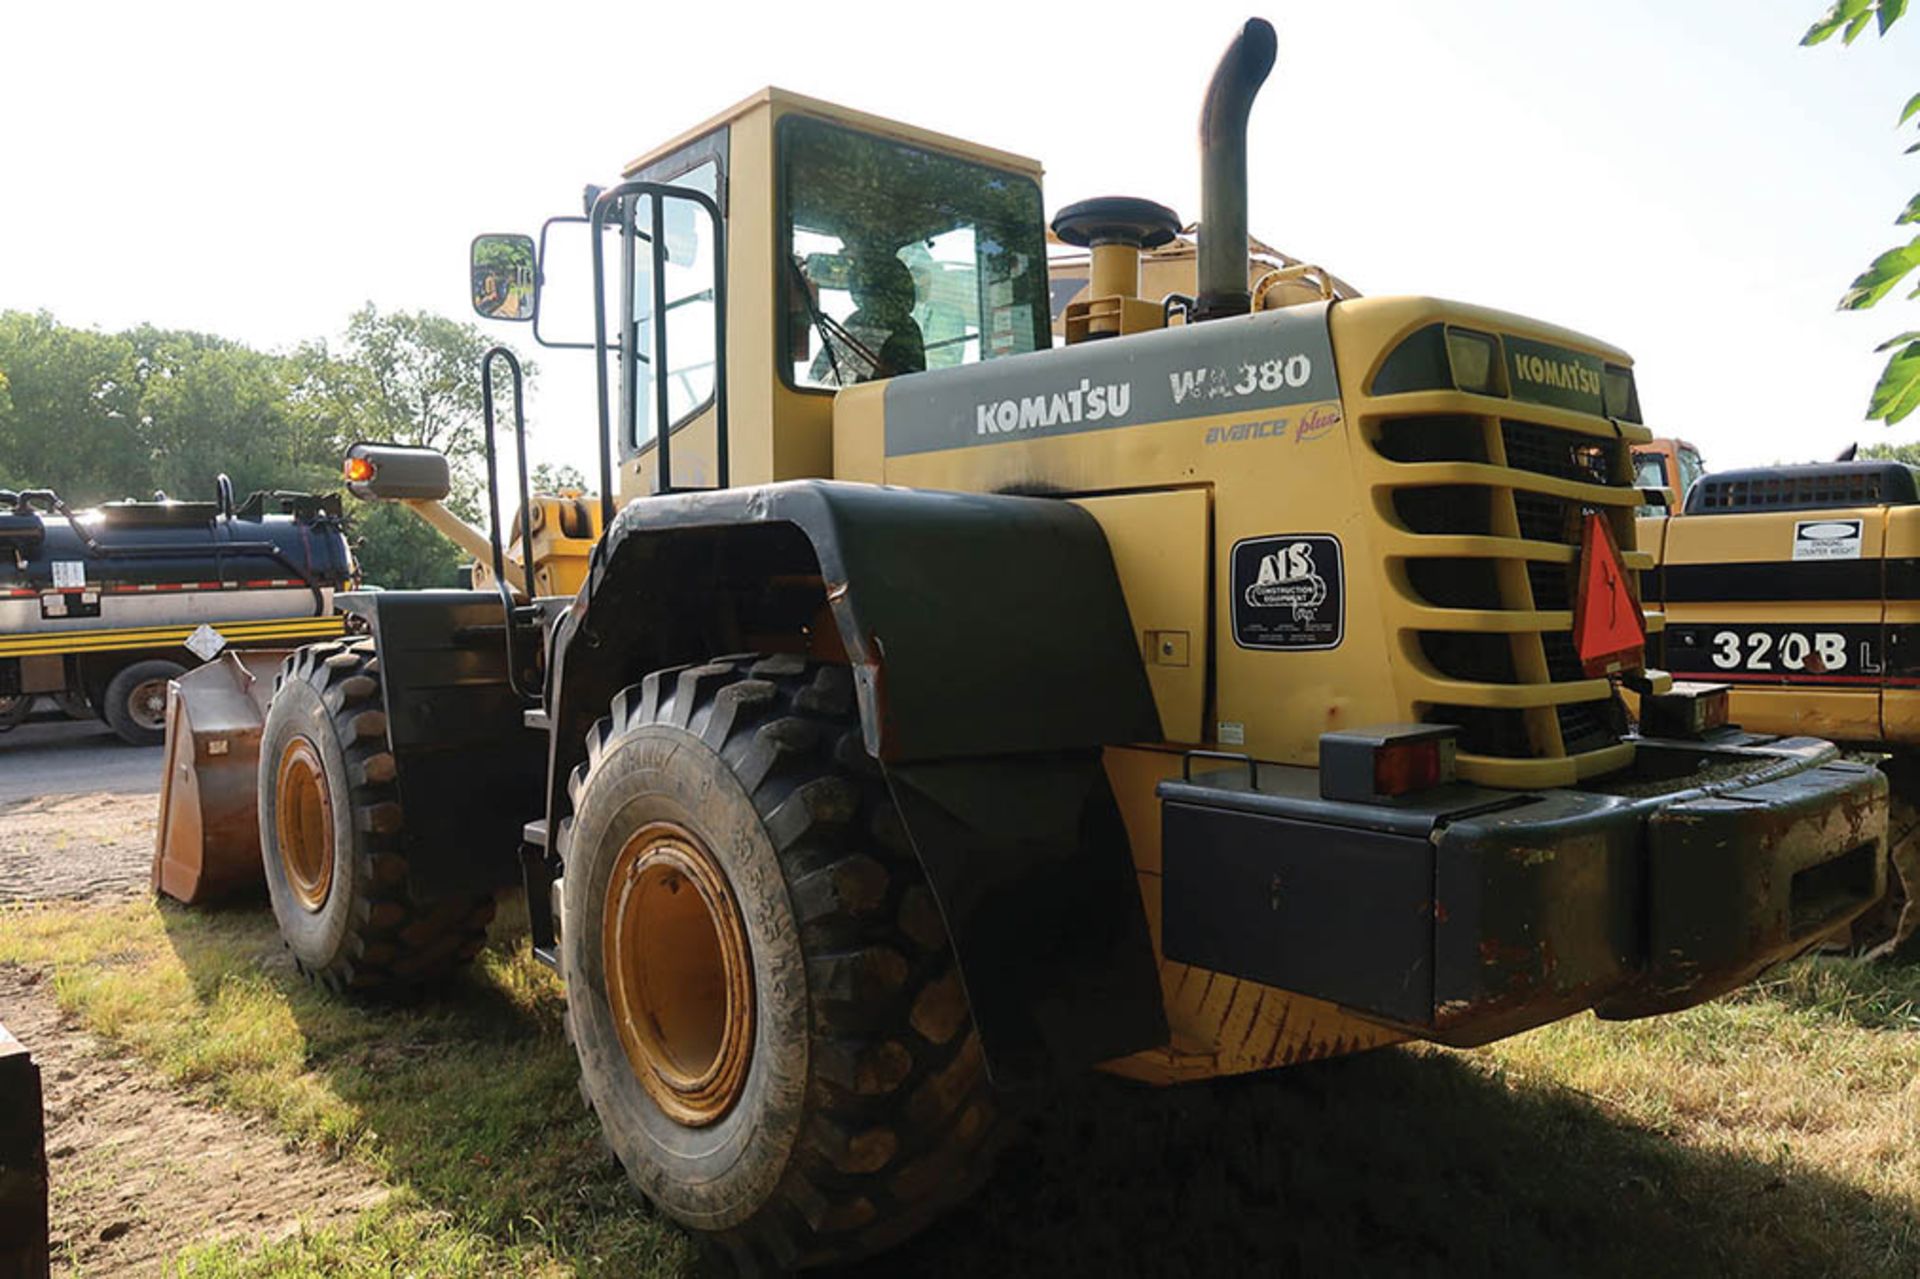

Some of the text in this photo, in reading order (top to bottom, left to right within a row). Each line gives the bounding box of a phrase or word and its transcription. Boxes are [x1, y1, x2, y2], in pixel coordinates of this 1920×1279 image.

[1515, 352, 1600, 394] KOMATSU
[976, 379, 1131, 436] KOMATSU
[1205, 406, 1341, 445] avance plus
[1258, 542, 1308, 585] AIS
[1712, 631, 1847, 671] 320B
